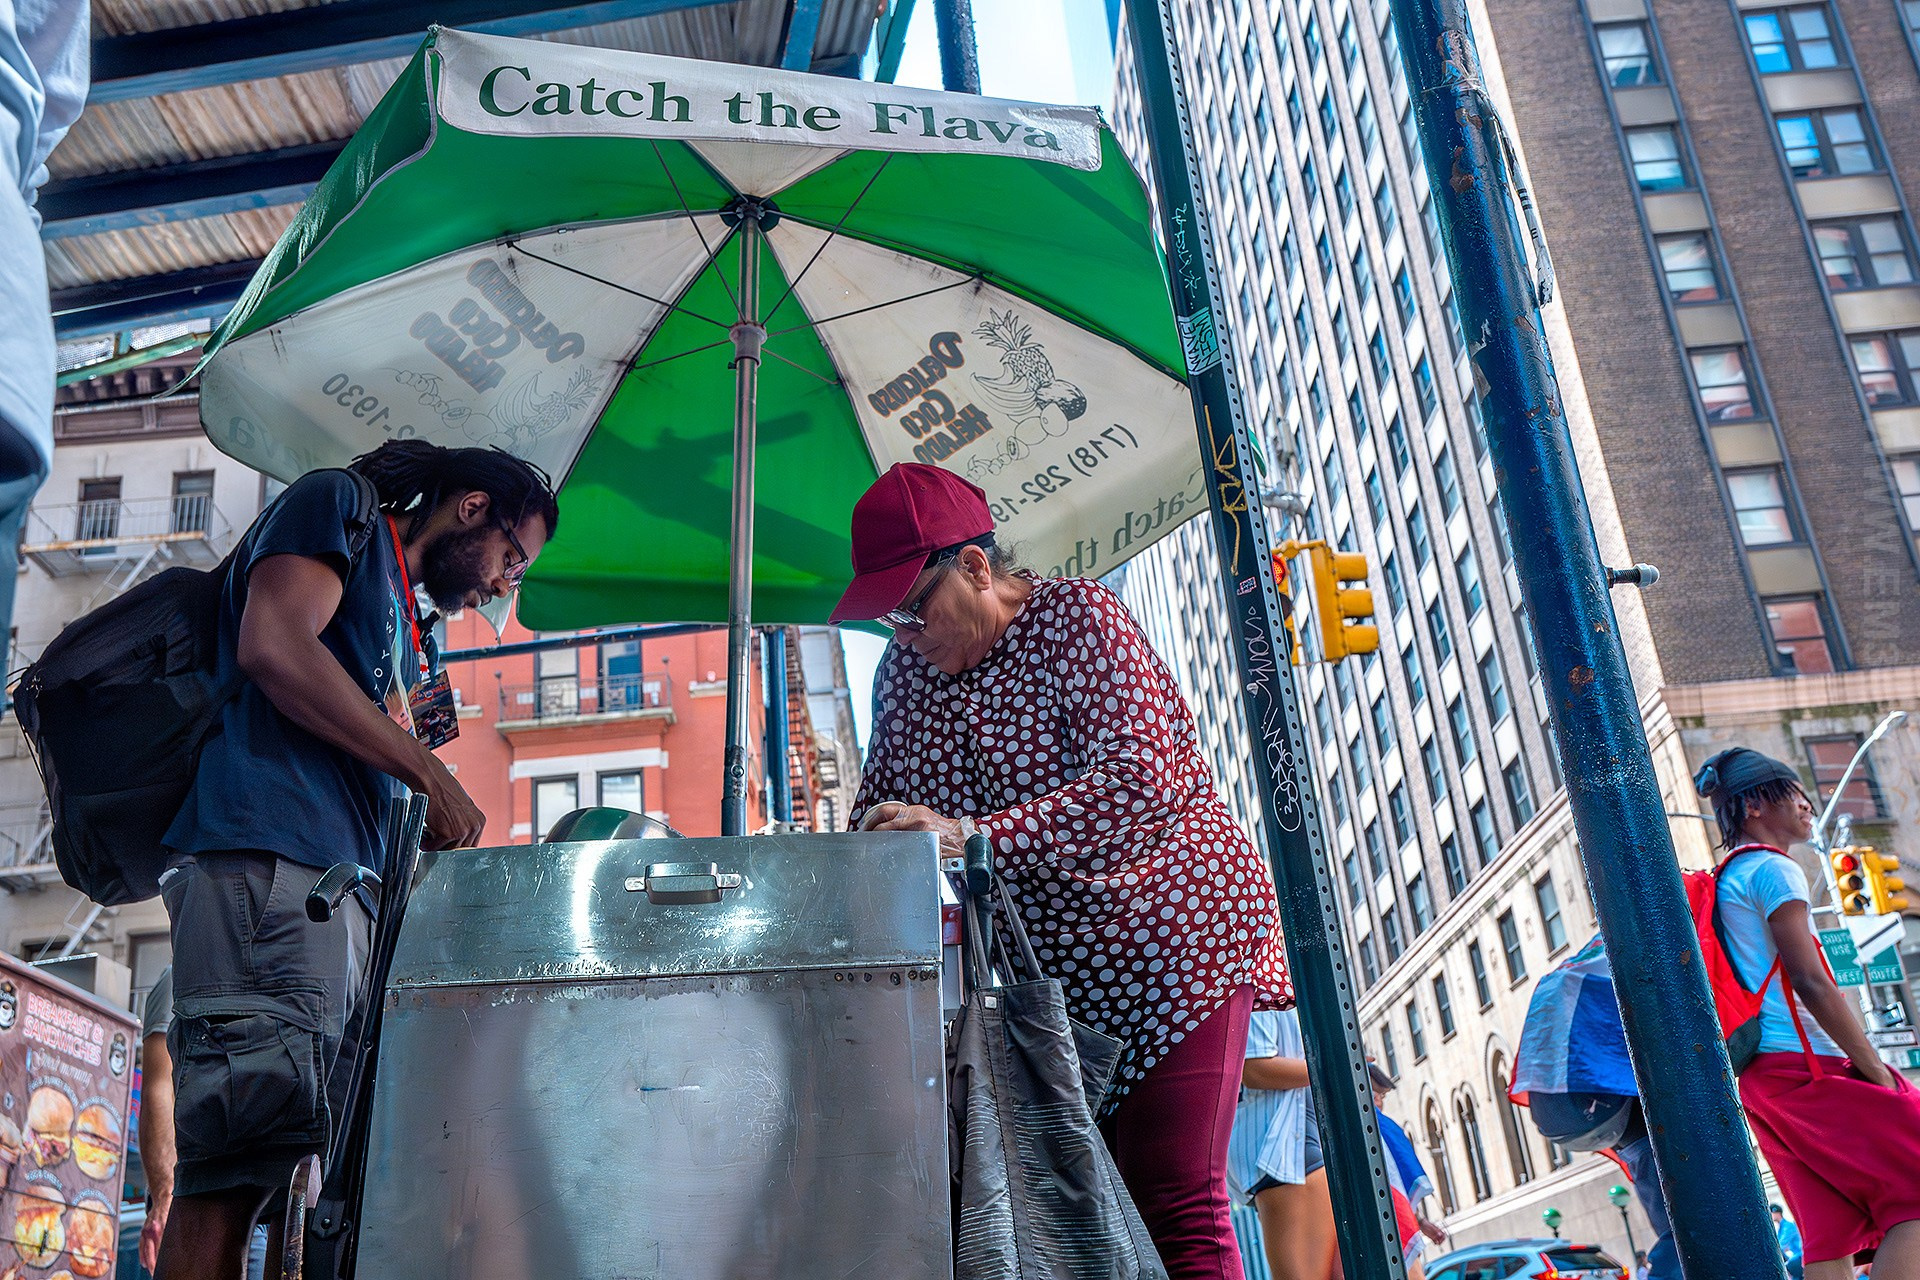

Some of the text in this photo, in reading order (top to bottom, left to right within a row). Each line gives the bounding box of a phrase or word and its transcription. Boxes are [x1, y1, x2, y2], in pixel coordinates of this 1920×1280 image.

[478, 65, 1062, 152] Catch the Flava
[23, 1014, 102, 1067] SANDWICHES
[28, 992, 93, 1041] BREAKFAST
